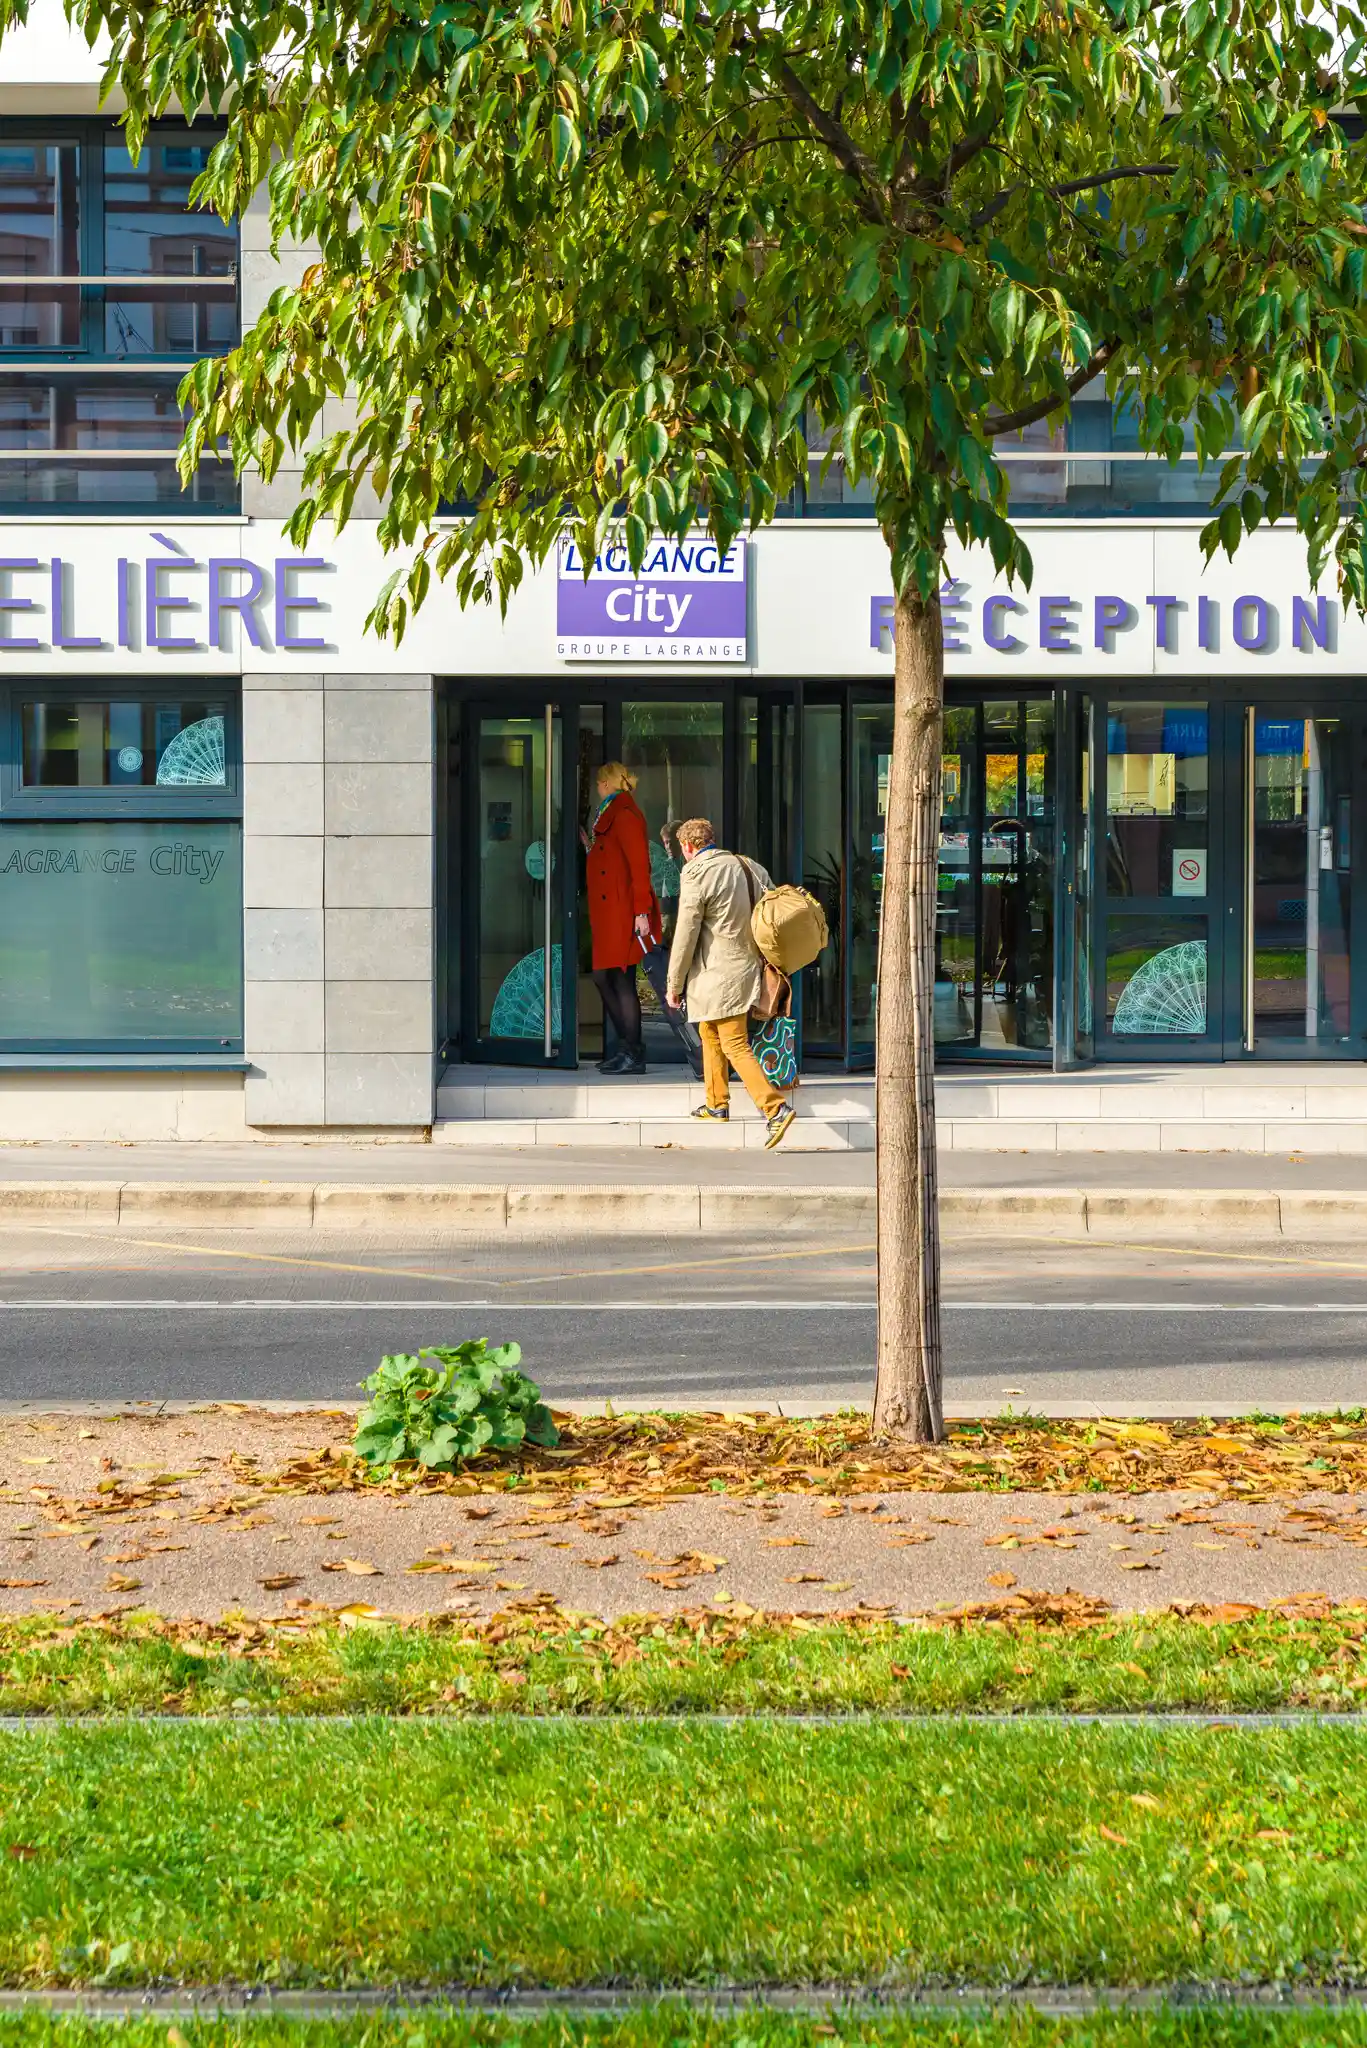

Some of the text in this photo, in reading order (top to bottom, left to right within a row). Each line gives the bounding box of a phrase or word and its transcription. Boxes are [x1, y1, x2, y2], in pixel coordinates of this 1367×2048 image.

[0, 533, 325, 647] ELIÈRE
[605, 584, 692, 633] City
[870, 577, 1327, 649] RÉCEPTION
[557, 643, 743, 656] GROUPE LAGRANGE
[149, 843, 224, 884] City
